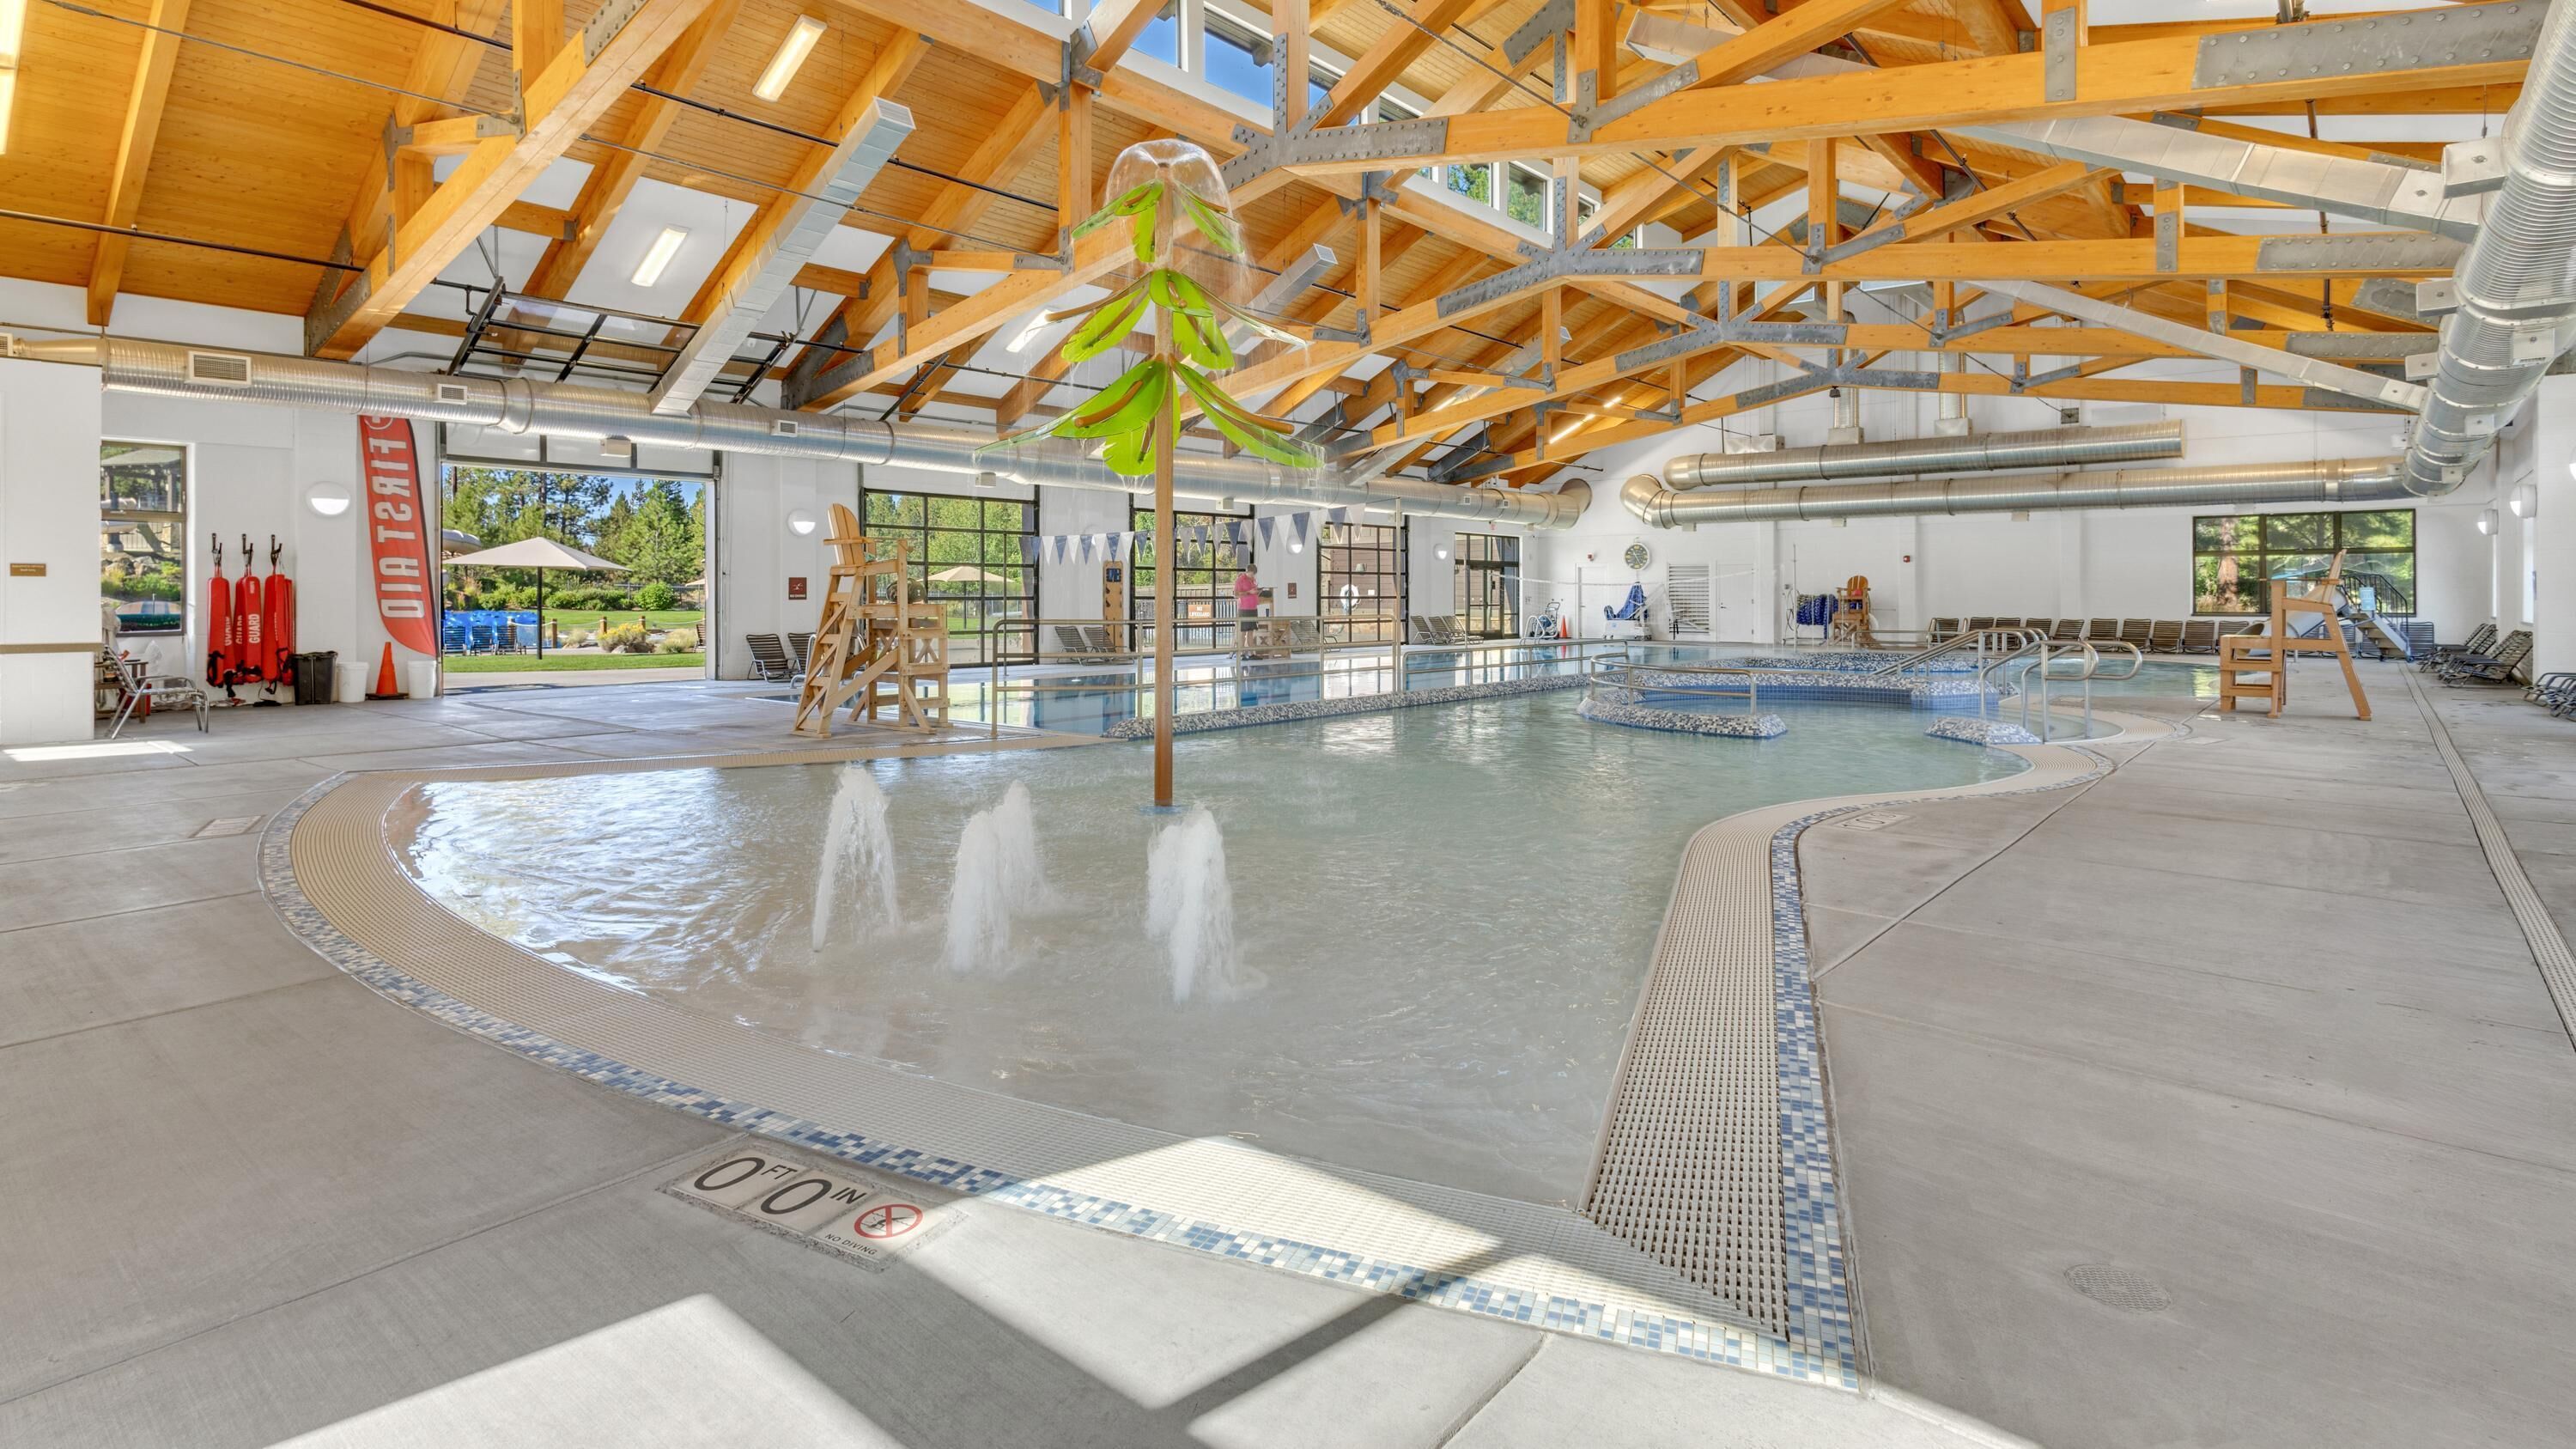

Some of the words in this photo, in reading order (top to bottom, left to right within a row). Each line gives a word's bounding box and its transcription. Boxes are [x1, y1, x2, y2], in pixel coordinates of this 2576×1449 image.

[248, 613, 261, 643] GUARD
[694, 1157, 766, 1190] 0
[761, 1164, 798, 1180] FT
[761, 1178, 833, 1215] 0
[829, 1187, 867, 1204] IN
[824, 1233, 841, 1243] NO
[841, 1239, 878, 1256] DIVING
